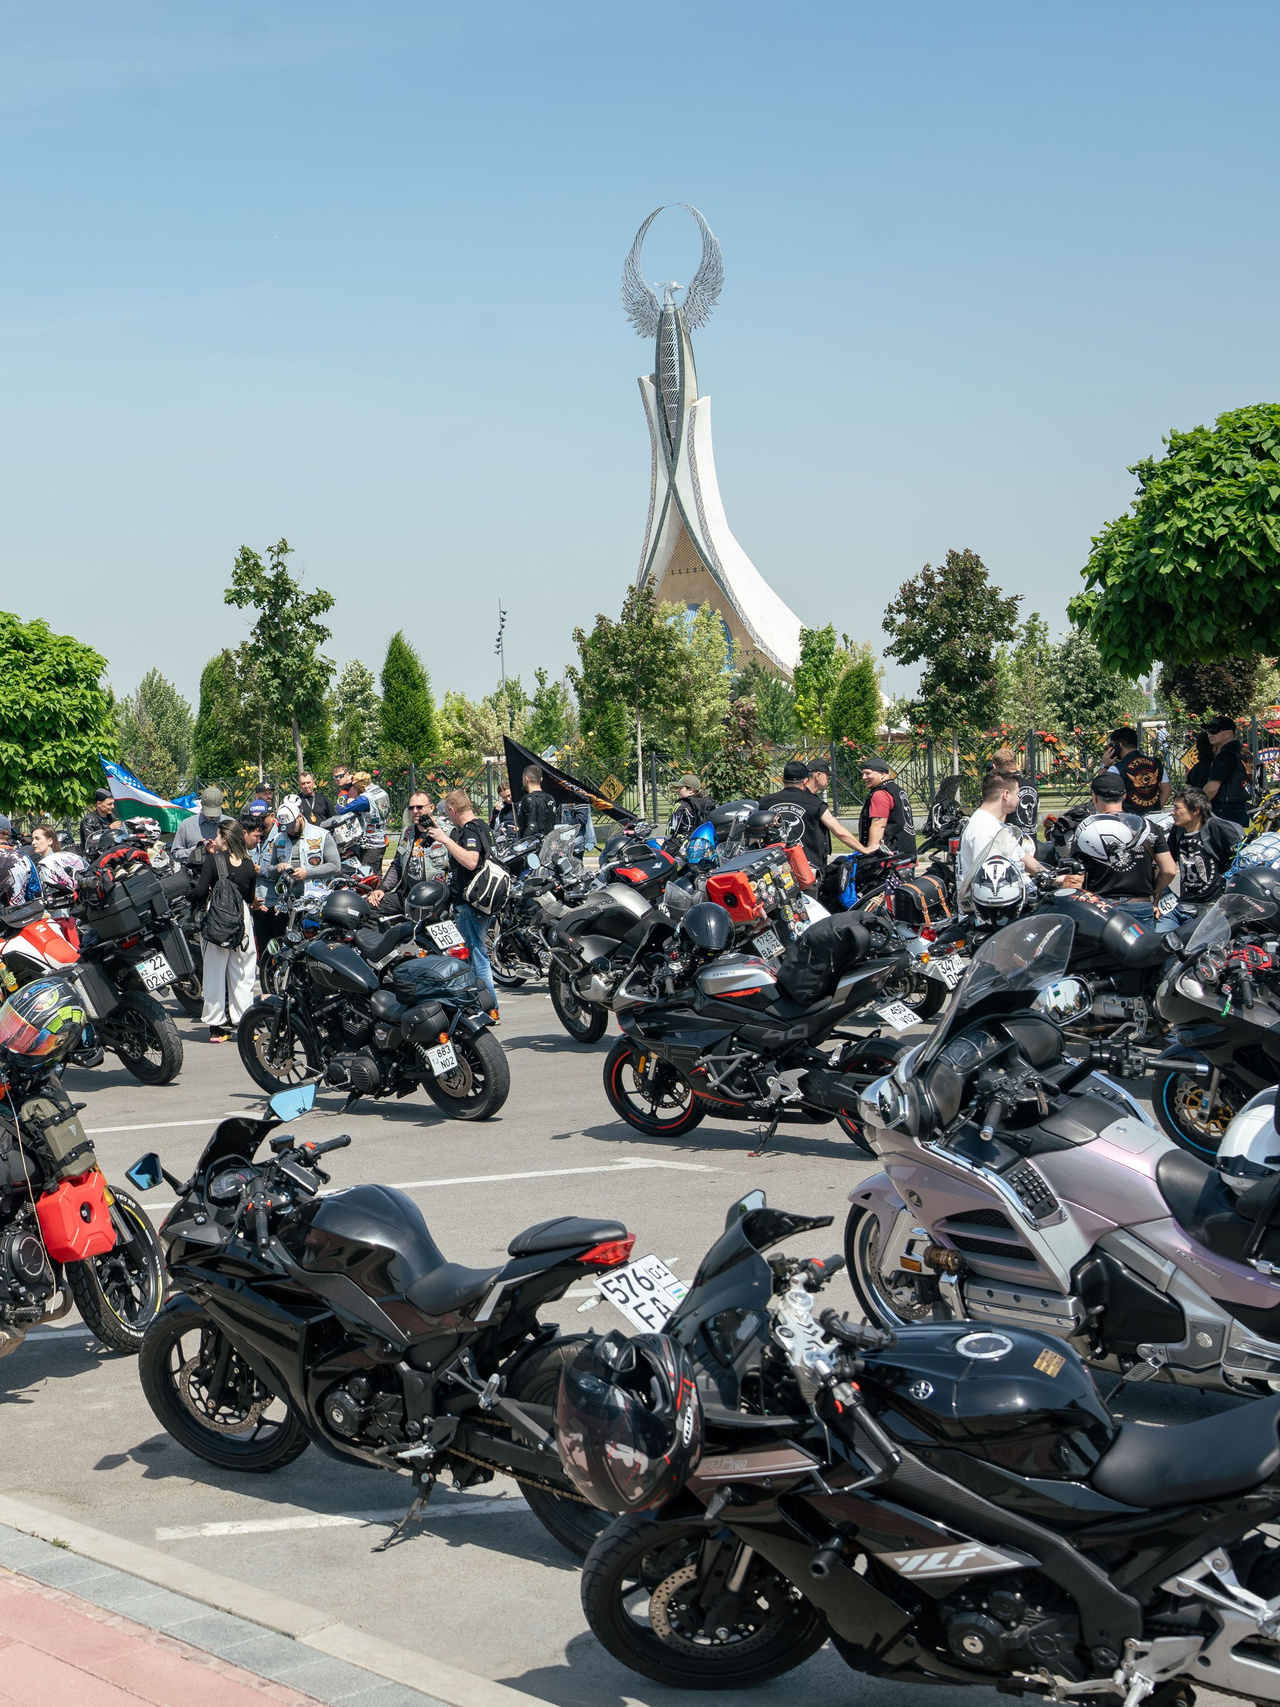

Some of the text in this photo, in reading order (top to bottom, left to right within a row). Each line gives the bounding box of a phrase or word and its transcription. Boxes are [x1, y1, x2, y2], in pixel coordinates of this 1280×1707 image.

[430, 924, 449, 938] 636
[438, 935, 454, 947] HD
[757, 932, 773, 945] 1725
[149, 956, 166, 971] 22
[938, 959, 955, 974] 347
[146, 969, 174, 989] 02 KB
[890, 1004, 907, 1016] 450
[436, 1045, 451, 1058] 883
[440, 1057, 456, 1070] N02
[601, 1264, 669, 1304] 576 01
[633, 1296, 673, 1330] FA
